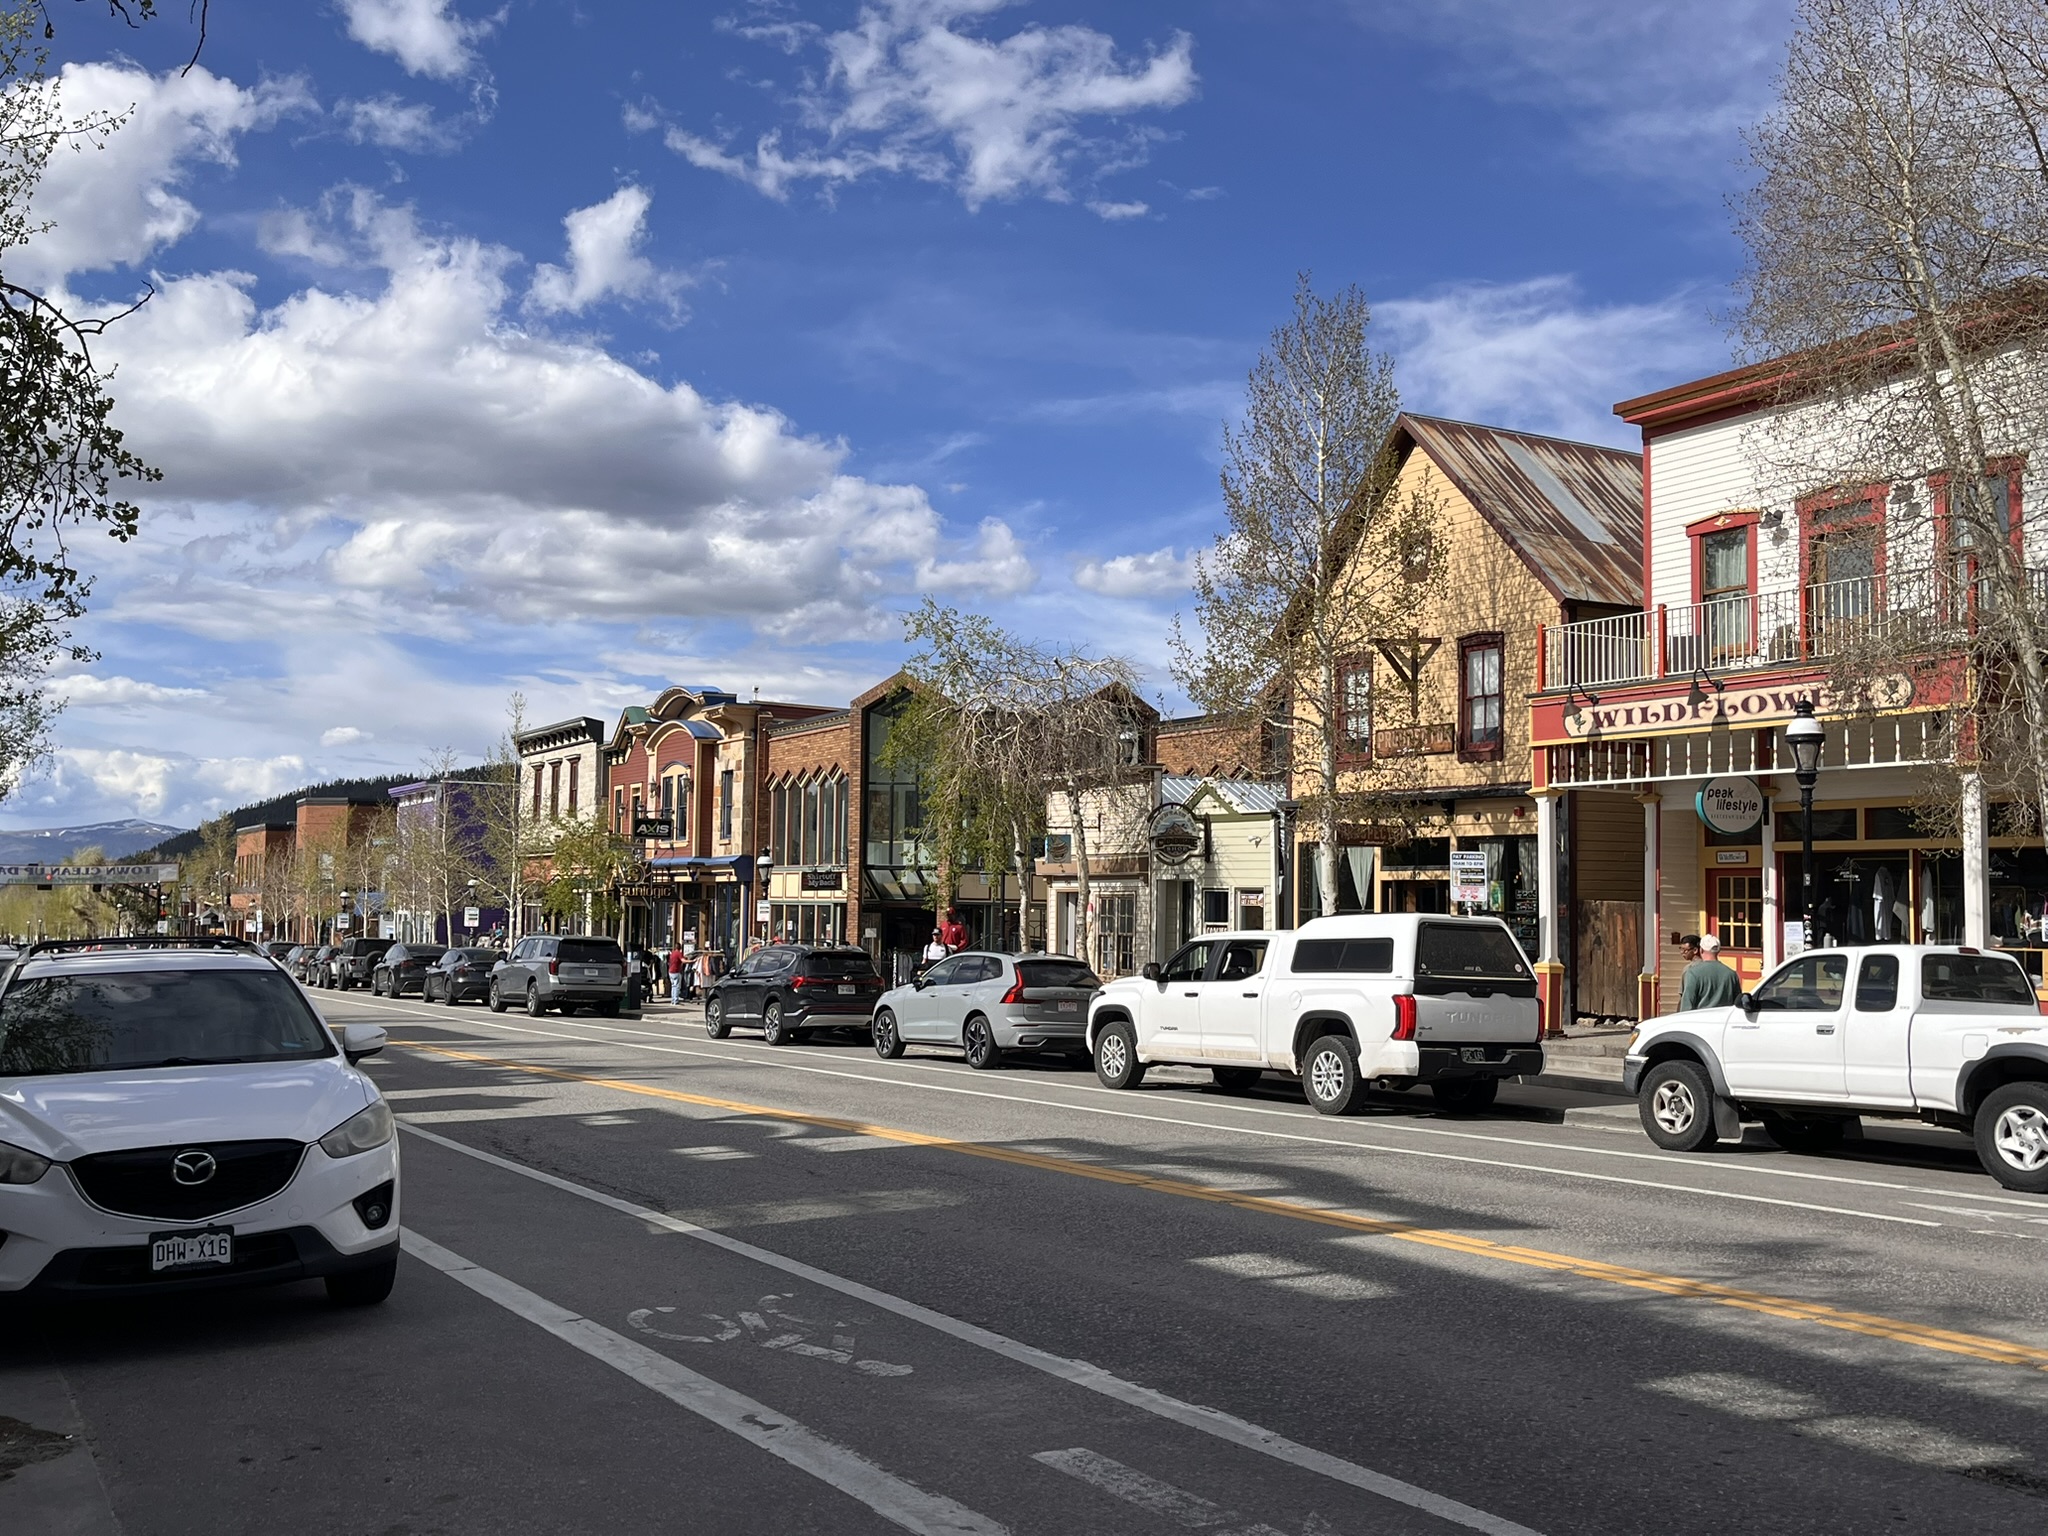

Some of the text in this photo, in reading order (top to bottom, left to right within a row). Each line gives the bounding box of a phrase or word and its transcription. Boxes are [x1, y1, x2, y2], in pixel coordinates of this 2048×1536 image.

[1591, 684, 1869, 729] WILDFLOWE
[1707, 787, 1734, 800] peak
[1716, 799, 1758, 814] lifestyle
[636, 821, 670, 833] AXIS
[620, 886, 671, 898] sunlogic
[1445, 1012, 1517, 1023] TUNDRA
